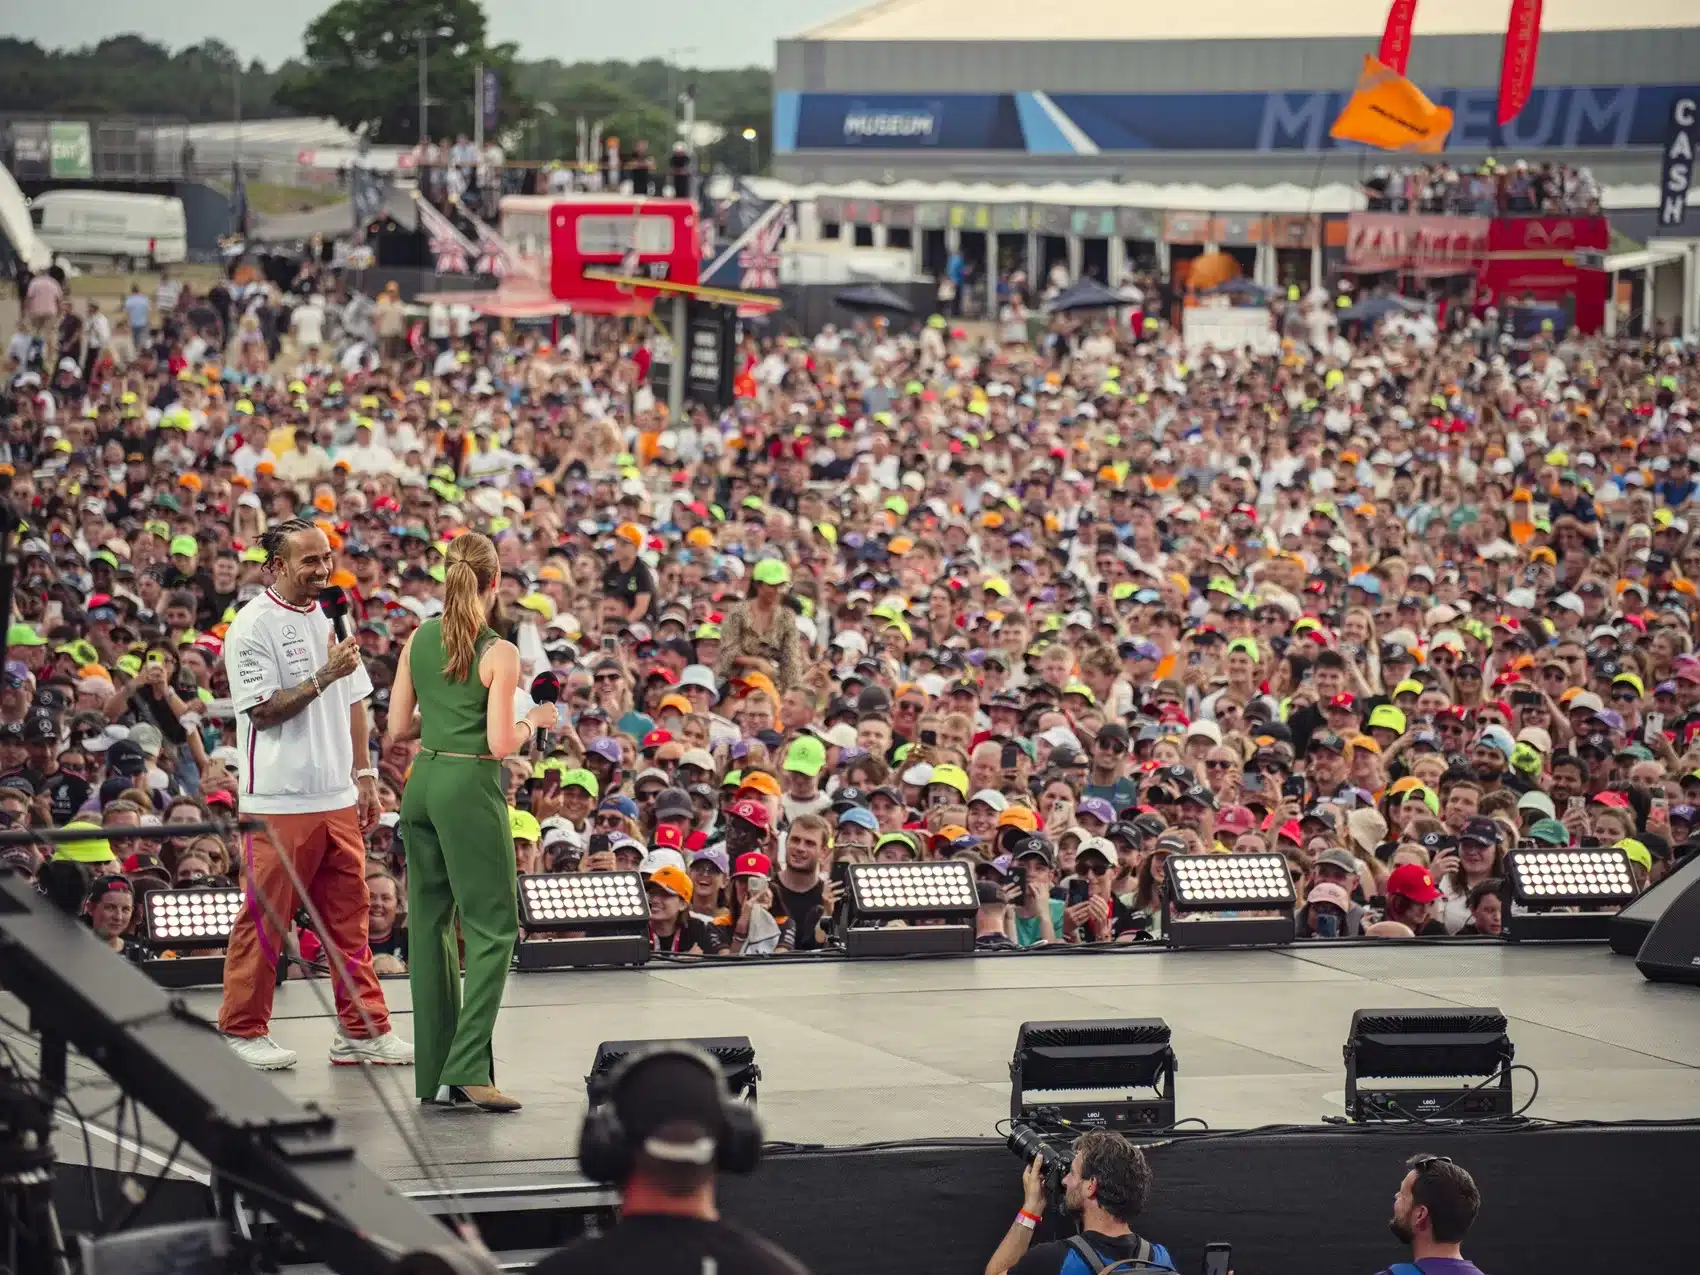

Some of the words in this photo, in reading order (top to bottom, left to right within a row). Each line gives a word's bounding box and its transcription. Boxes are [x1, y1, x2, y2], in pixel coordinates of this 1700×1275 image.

[843, 113, 934, 136] MUSEUM
[1256, 86, 1641, 151] MEUM
[1663, 97, 1697, 224] CASH
[243, 674, 264, 684] nuvei
